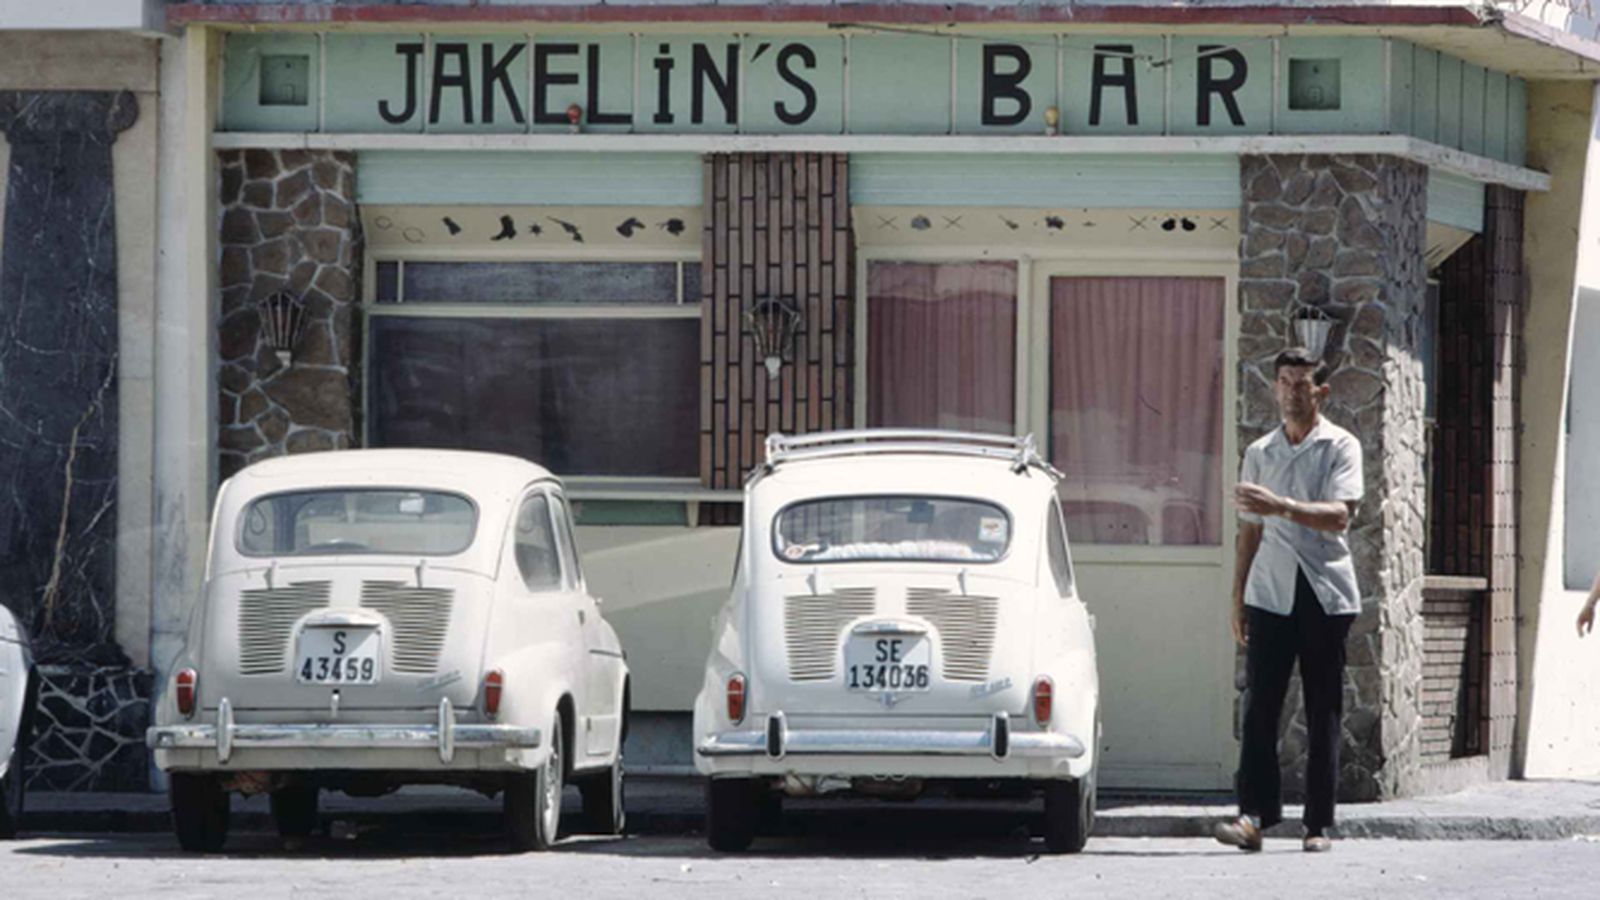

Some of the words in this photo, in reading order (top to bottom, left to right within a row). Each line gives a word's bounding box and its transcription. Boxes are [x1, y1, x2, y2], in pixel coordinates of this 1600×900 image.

[980, 43, 1248, 127] BAR
[332, 630, 348, 656] S
[875, 638, 904, 663] SE
[300, 656, 375, 682] 43459
[848, 664, 930, 690] 134036
